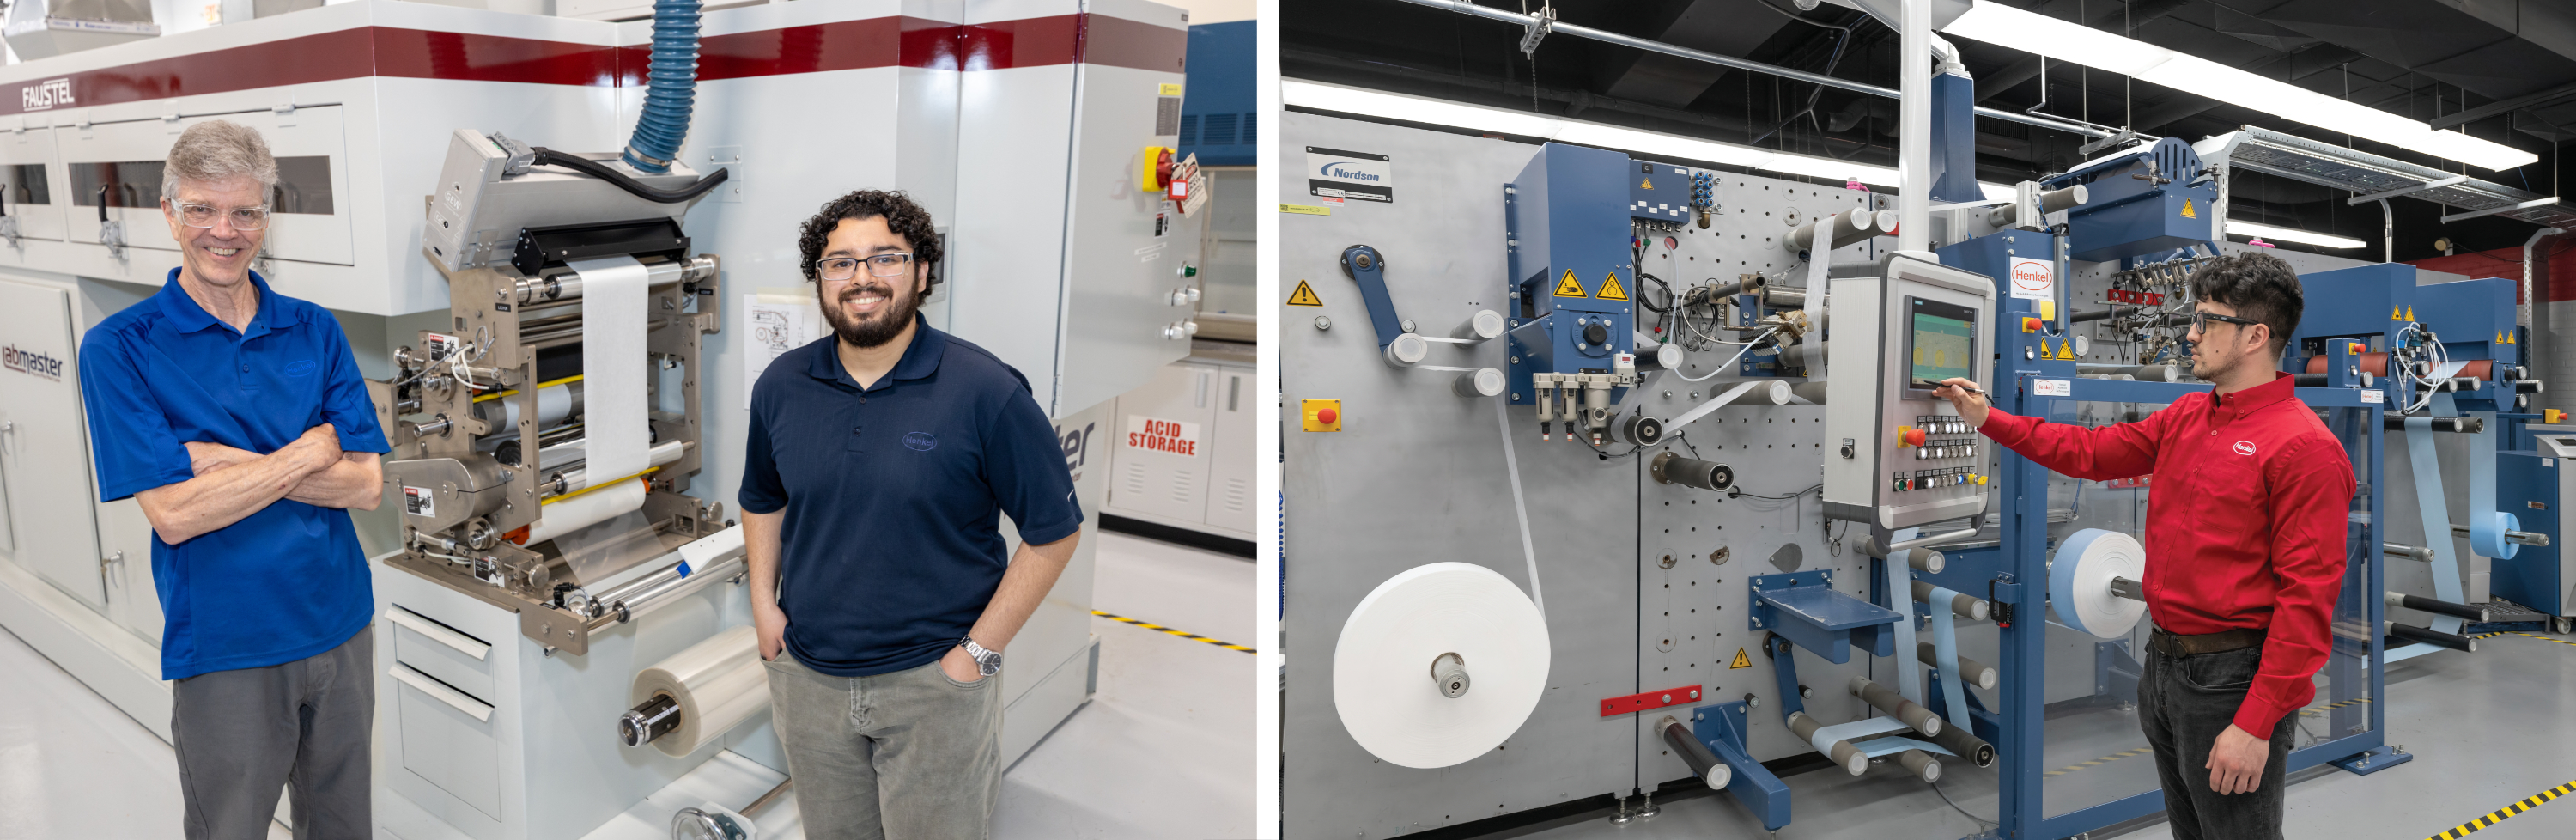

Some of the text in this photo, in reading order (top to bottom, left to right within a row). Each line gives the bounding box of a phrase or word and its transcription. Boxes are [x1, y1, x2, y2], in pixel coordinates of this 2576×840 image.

[22, 81, 75, 109] FAUSTEL
[1334, 167, 1379, 181] Nordson
[446, 192, 461, 210] GEW
[2015, 269, 2049, 283] Henkel
[287, 362, 313, 374] Henkel
[1145, 419, 1181, 437] ACID
[906, 436, 933, 447] Henkel
[1129, 432, 1195, 455] STORAGE
[2234, 442, 2254, 453] Henkel
